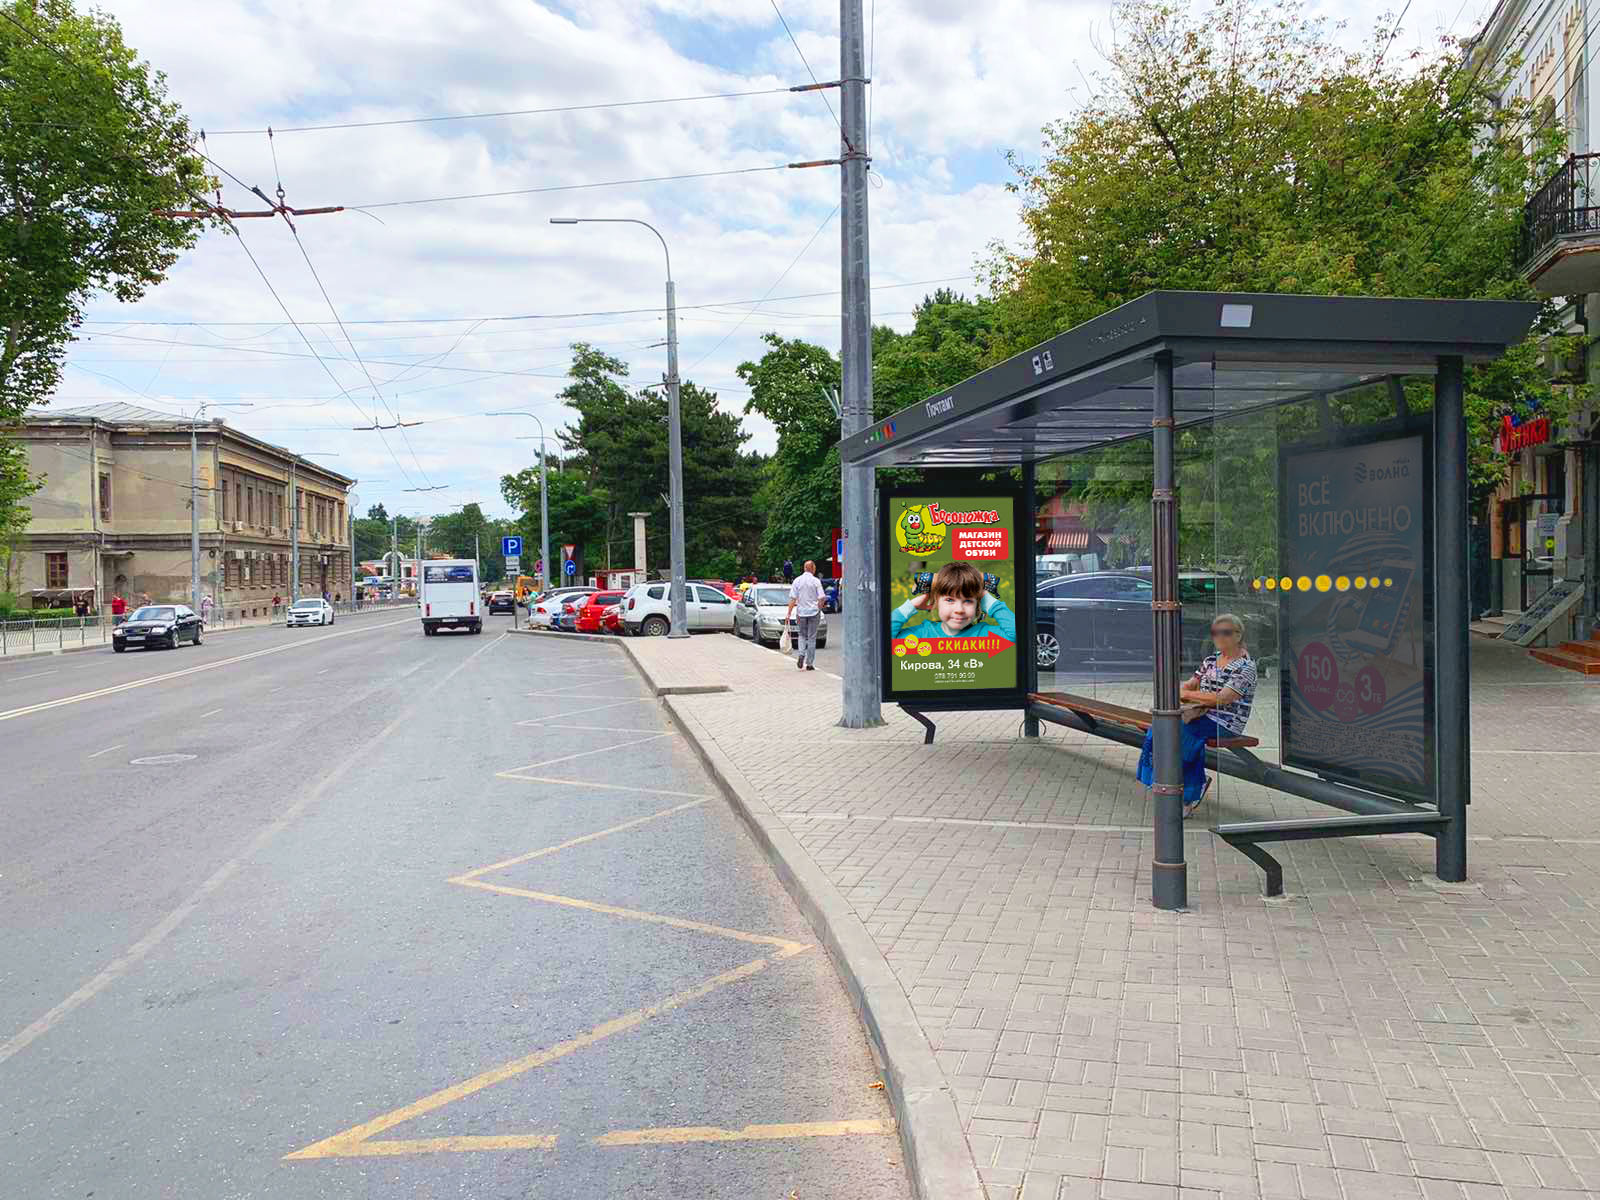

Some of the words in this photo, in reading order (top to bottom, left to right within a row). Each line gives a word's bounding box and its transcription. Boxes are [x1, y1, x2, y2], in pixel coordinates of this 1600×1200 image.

[926, 396, 955, 418] Почтамт
[1298, 474, 1331, 507] ВСЁ
[928, 502, 1000, 526] Босоножка
[1298, 505, 1412, 537] ВКЛЮЧЕНО
[959, 531, 1002, 539] МАГАЗИН
[959, 538, 1002, 548] ДЕТСКОЙ
[508, 539, 518, 553] P
[965, 549, 996, 557] ОБУВИ
[938, 639, 1000, 651] СКИДКИ!!!
[900, 660, 945, 672] Кирова,
[947, 659, 961, 669] 34
[963, 658, 984, 669] «В»
[1303, 655, 1332, 681] 150
[1360, 674, 1373, 701] 3
